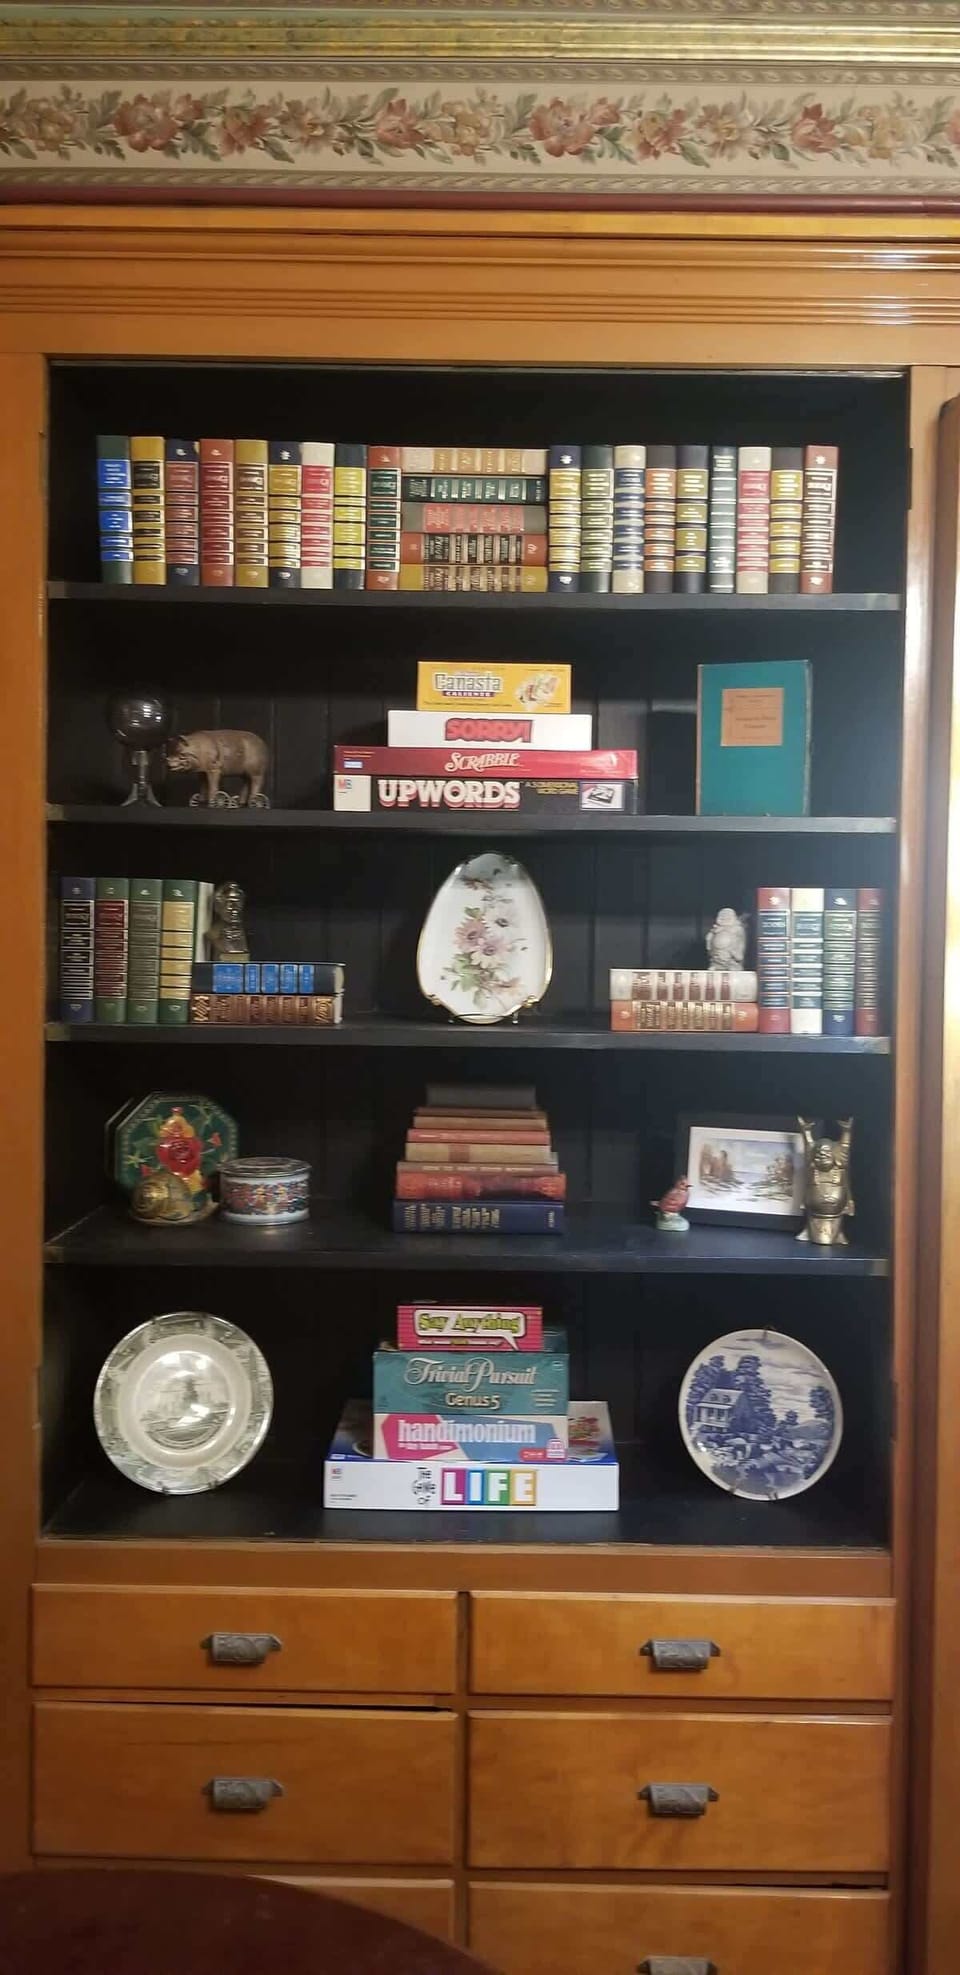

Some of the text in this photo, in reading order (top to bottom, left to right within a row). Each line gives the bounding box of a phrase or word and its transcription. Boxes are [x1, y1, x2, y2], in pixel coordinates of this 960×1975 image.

[434, 672, 502, 691] Canasta
[445, 717, 534, 744] SORRY!
[445, 752, 522, 772] SCRABBLE
[378, 778, 522, 809] UPWORDS
[419, 1313, 521, 1334] Say Anything
[404, 1357, 538, 1393] Trivial Pursuit
[446, 1393, 501, 1410] Genus 5
[398, 1420, 536, 1443] handimonium
[443, 1471, 535, 1503] LIFE
